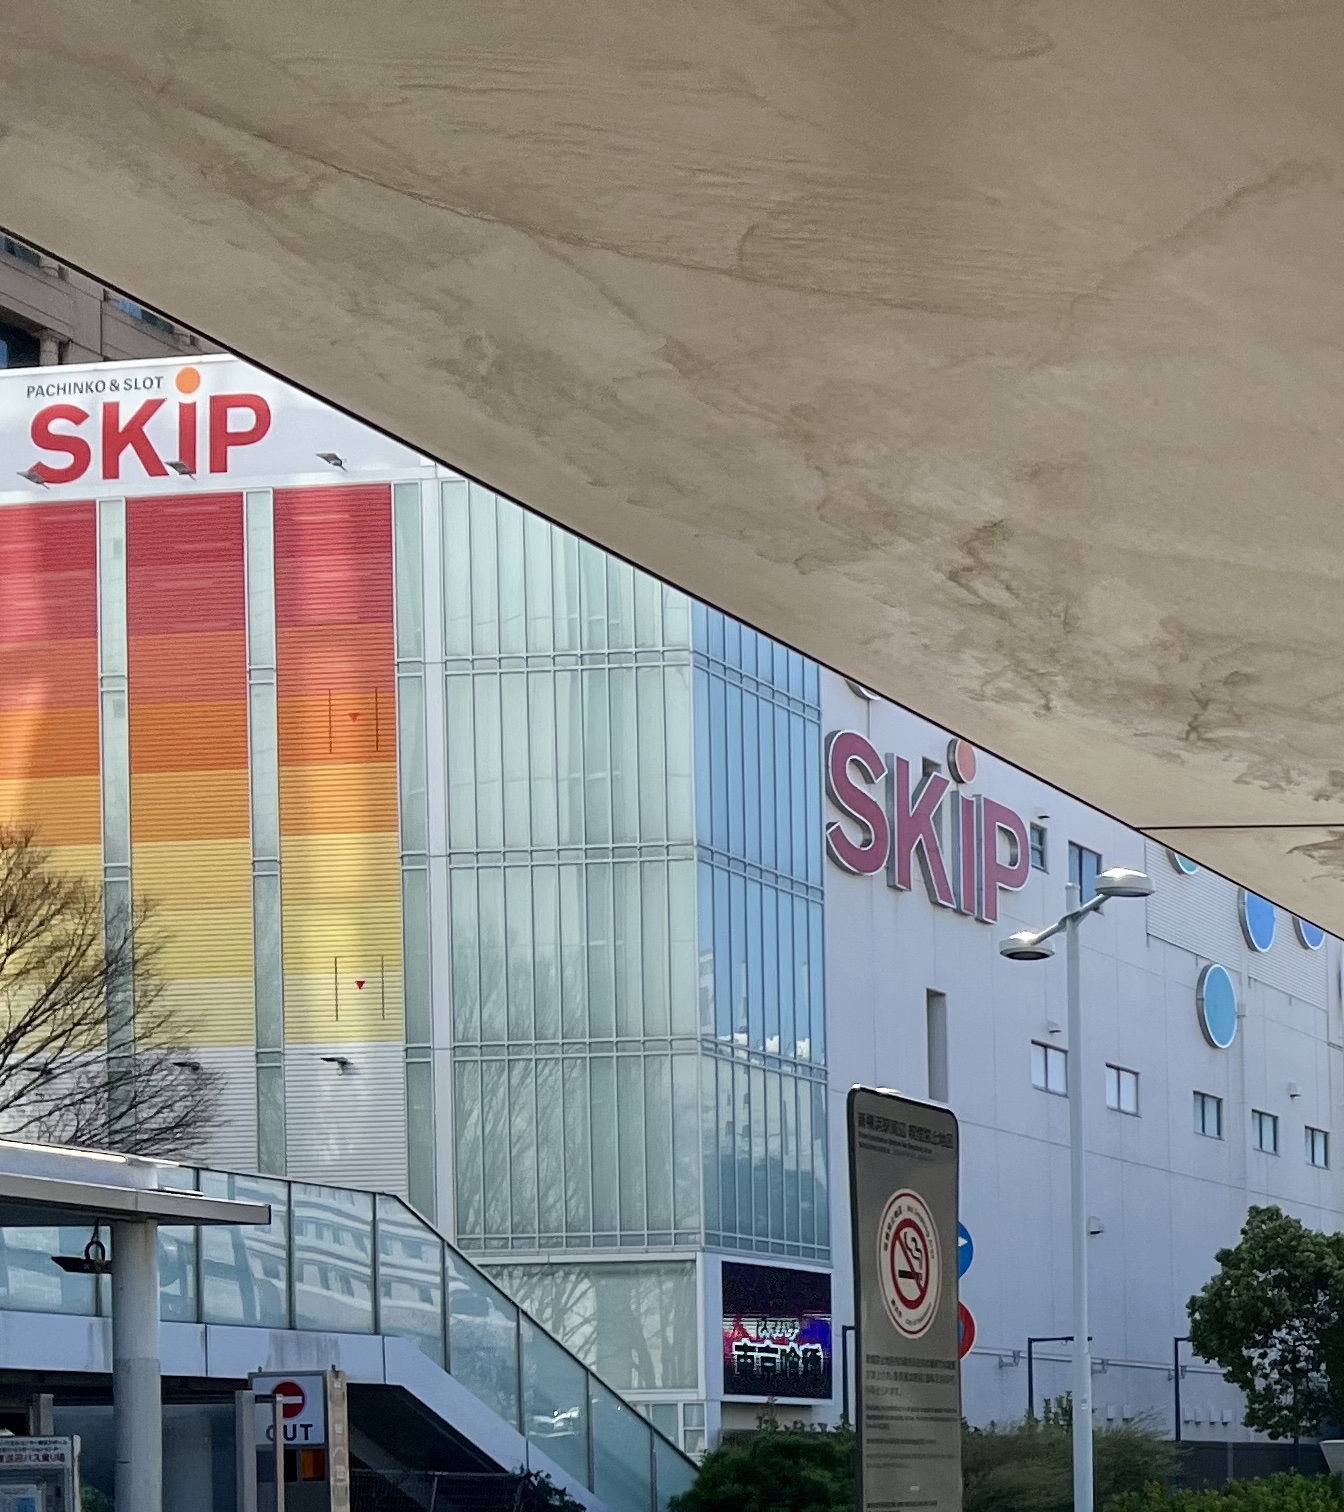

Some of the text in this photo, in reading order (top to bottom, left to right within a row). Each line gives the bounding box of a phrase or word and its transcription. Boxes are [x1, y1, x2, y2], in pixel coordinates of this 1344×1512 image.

[26, 375, 164, 399] PACHINKO & SLOT
[29, 366, 272, 485] SKiP
[825, 729, 1030, 925] SKiP
